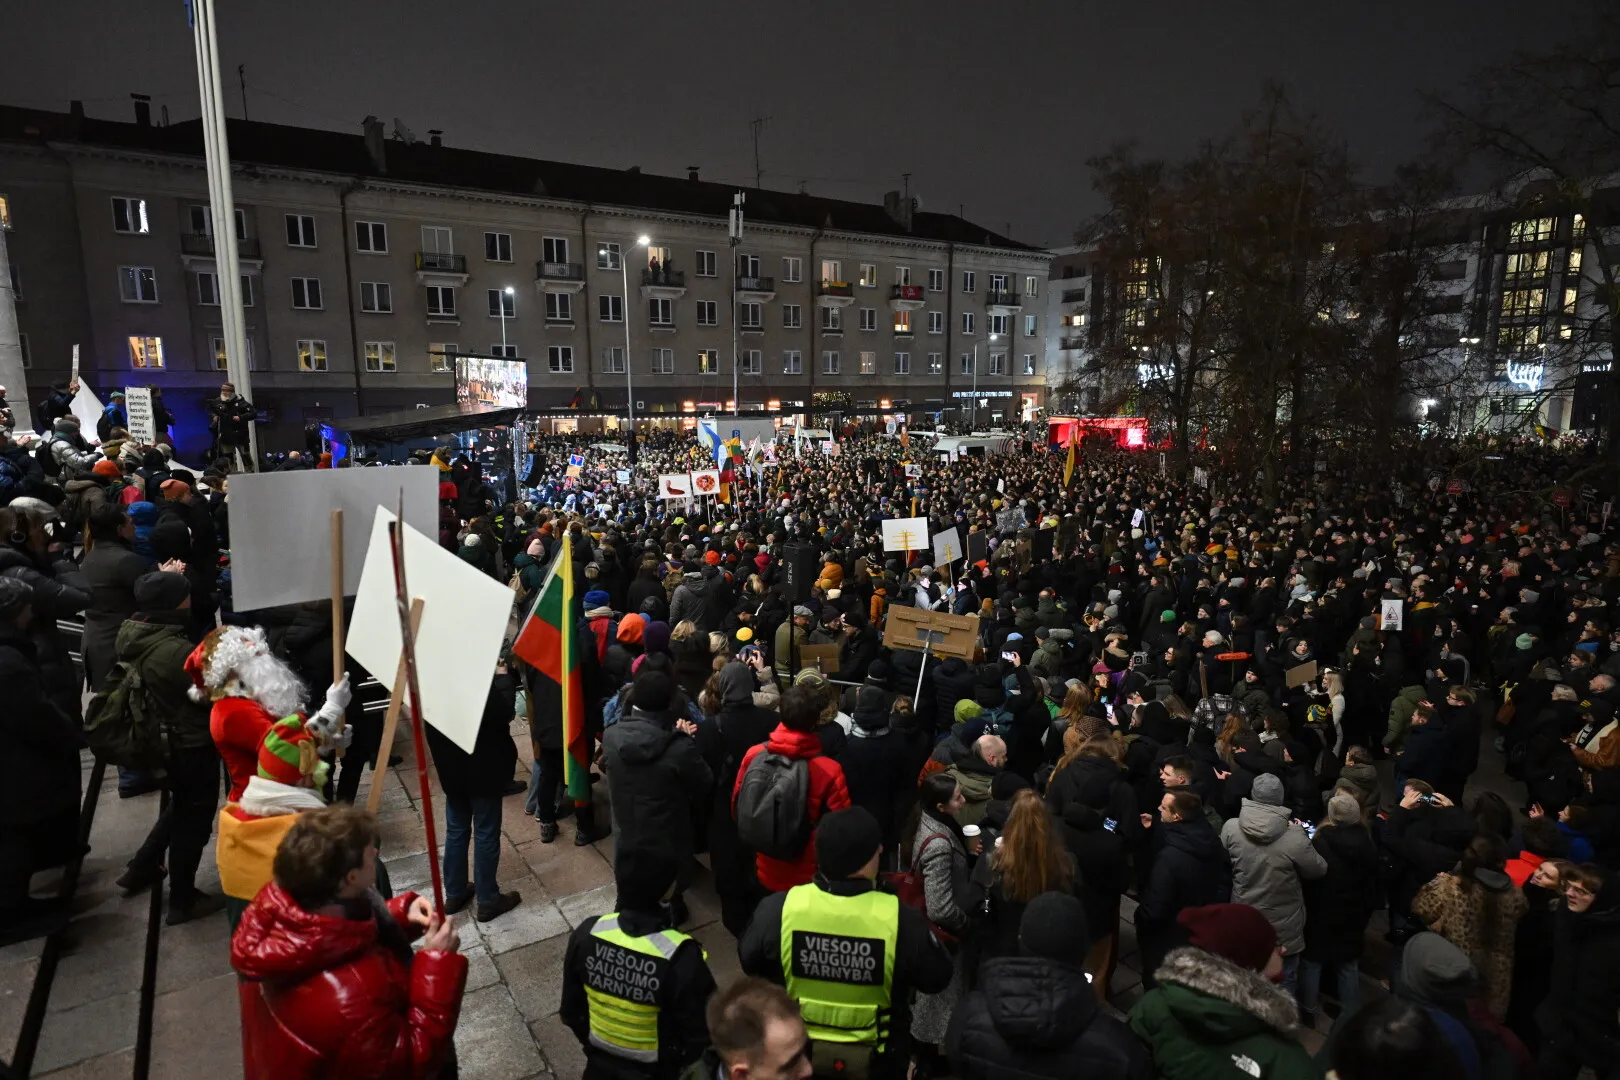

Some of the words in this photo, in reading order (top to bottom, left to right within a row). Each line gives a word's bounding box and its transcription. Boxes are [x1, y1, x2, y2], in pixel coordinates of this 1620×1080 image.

[595, 943, 657, 975] VIEŠOJO
[805, 935, 871, 956] VIEŠOJO
[585, 956, 660, 991] SAUGUMO
[800, 949, 876, 971] SAUGUMO
[801, 963, 873, 982] TARNYBA
[587, 971, 656, 1003] TARNYBA
